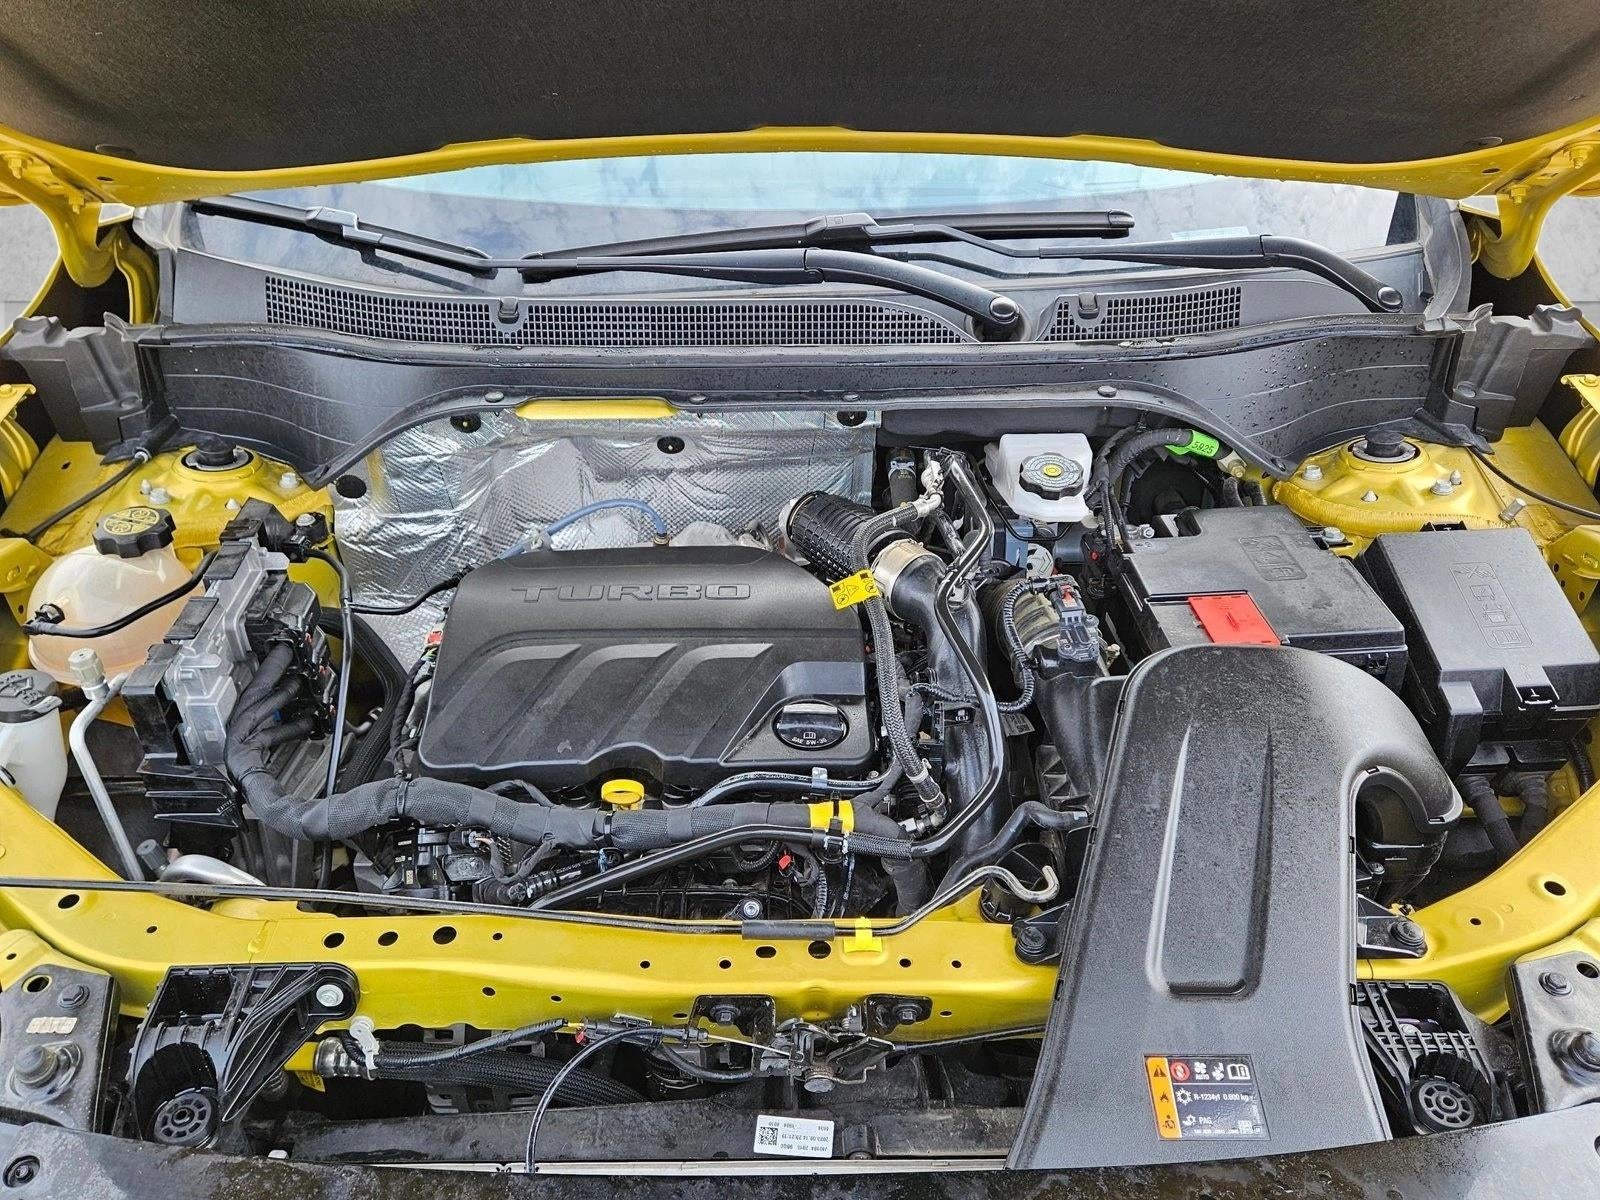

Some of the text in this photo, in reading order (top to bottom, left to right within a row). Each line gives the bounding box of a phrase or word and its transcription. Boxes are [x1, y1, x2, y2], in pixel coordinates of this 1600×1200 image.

[511, 584, 751, 602] TURBO
[1193, 1093, 1221, 1102] R-1234yf
[1240, 1093, 1249, 1102] kg
[1198, 1116, 1213, 1125] PAG
